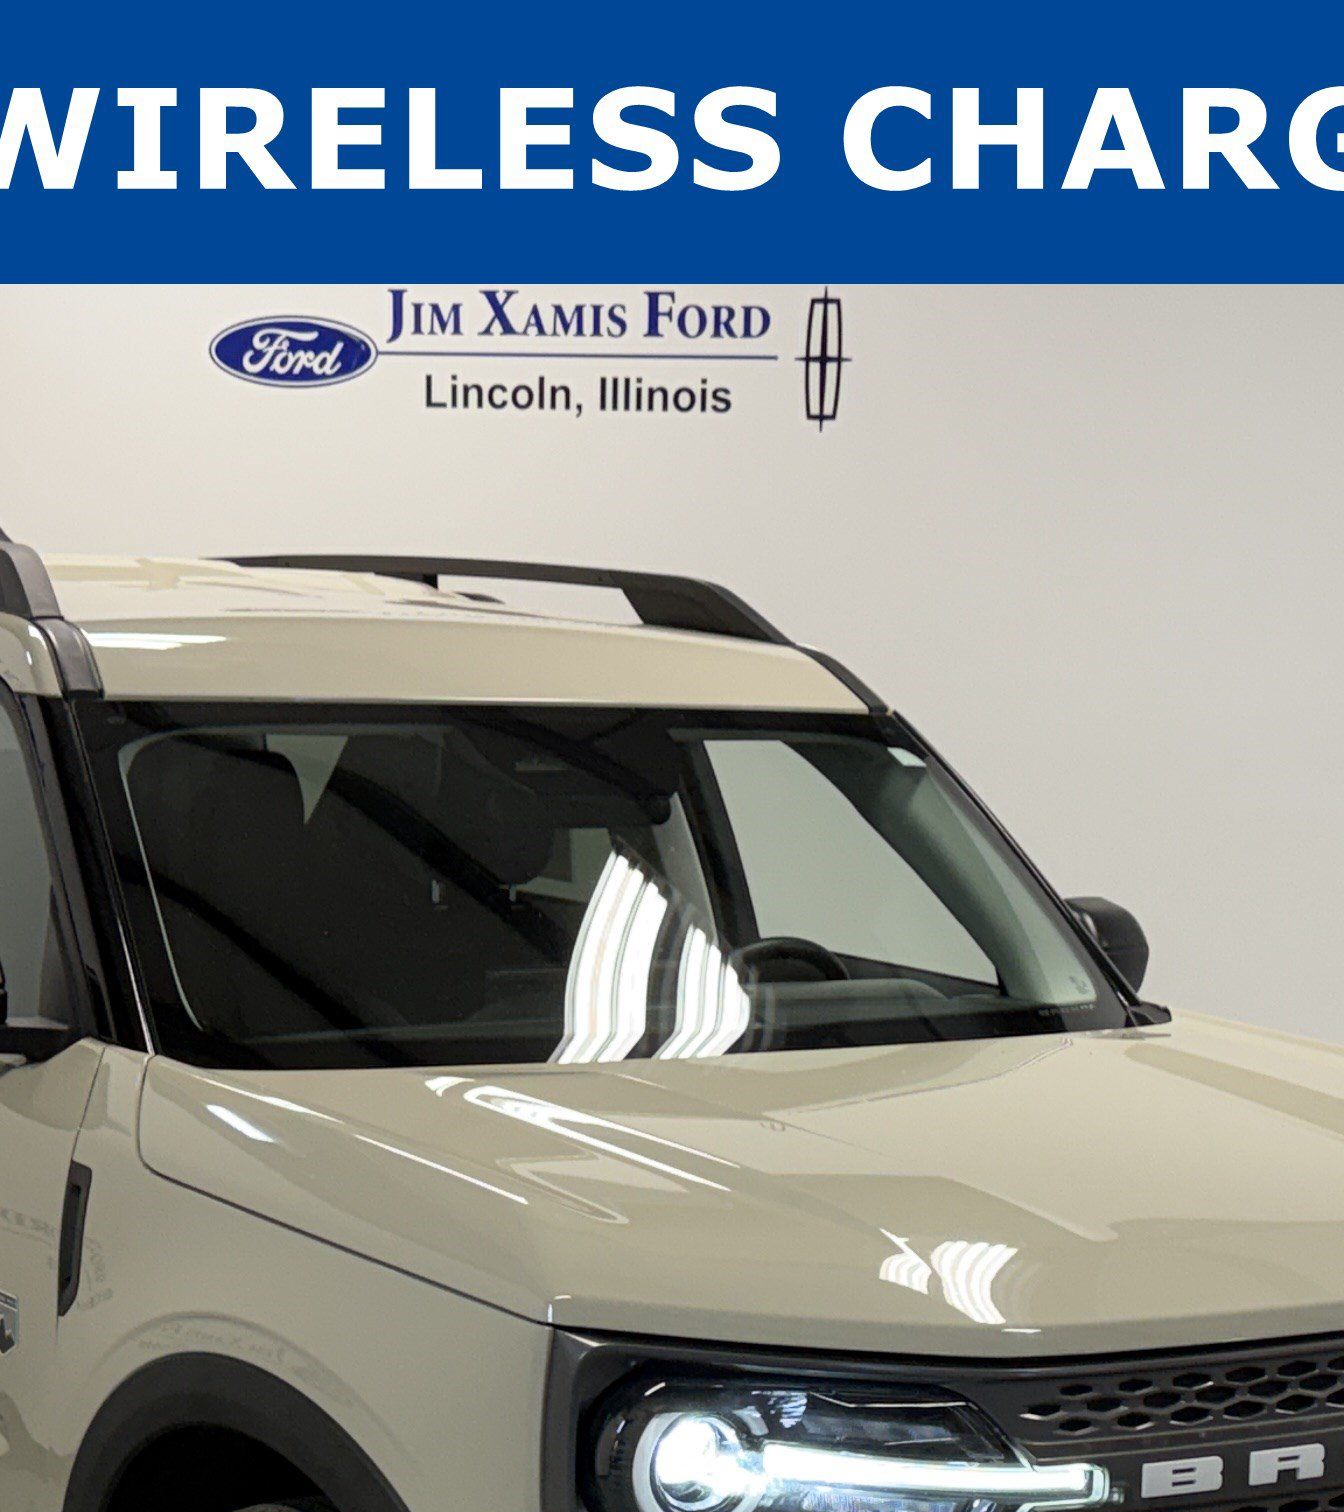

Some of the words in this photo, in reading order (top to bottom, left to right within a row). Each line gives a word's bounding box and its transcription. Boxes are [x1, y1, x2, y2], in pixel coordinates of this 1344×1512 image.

[386, 289, 462, 343] JIM
[478, 290, 627, 338] XAMIS
[643, 291, 771, 339] FORD
[242, 327, 344, 377] Ford
[425, 374, 582, 417] Lincoln,
[599, 376, 732, 413] Illinois
